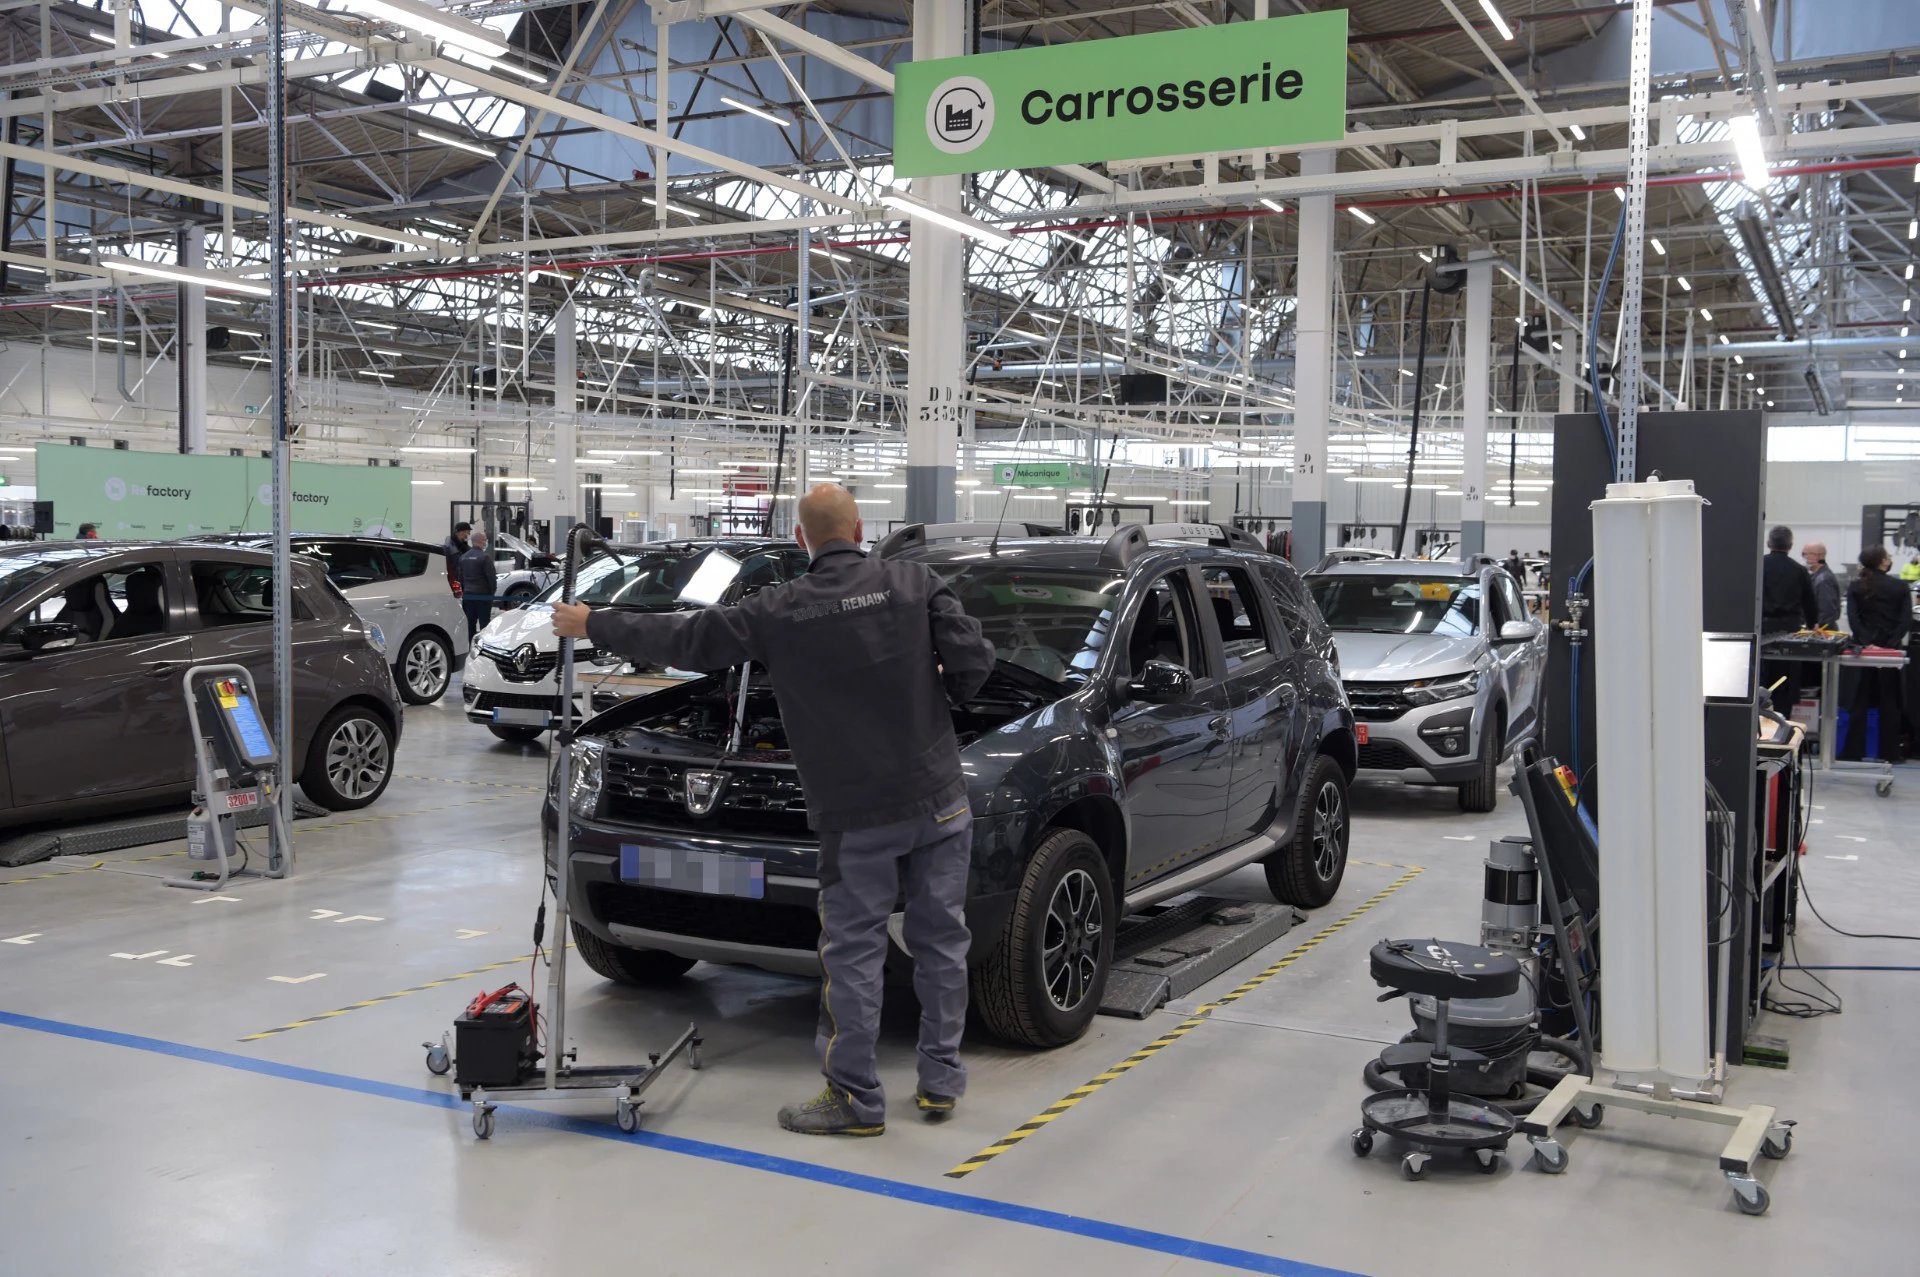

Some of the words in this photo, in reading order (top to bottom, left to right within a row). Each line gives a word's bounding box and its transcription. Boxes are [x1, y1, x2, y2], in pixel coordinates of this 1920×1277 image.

[1021, 61, 1303, 125] Carrosserie
[929, 387, 939, 401] D
[946, 387, 952, 401] D
[1304, 453, 1311, 463] D
[1017, 469, 1060, 478] Mécanique
[1180, 526, 1221, 536] DUSTER
[228, 793, 248, 807] 3200
